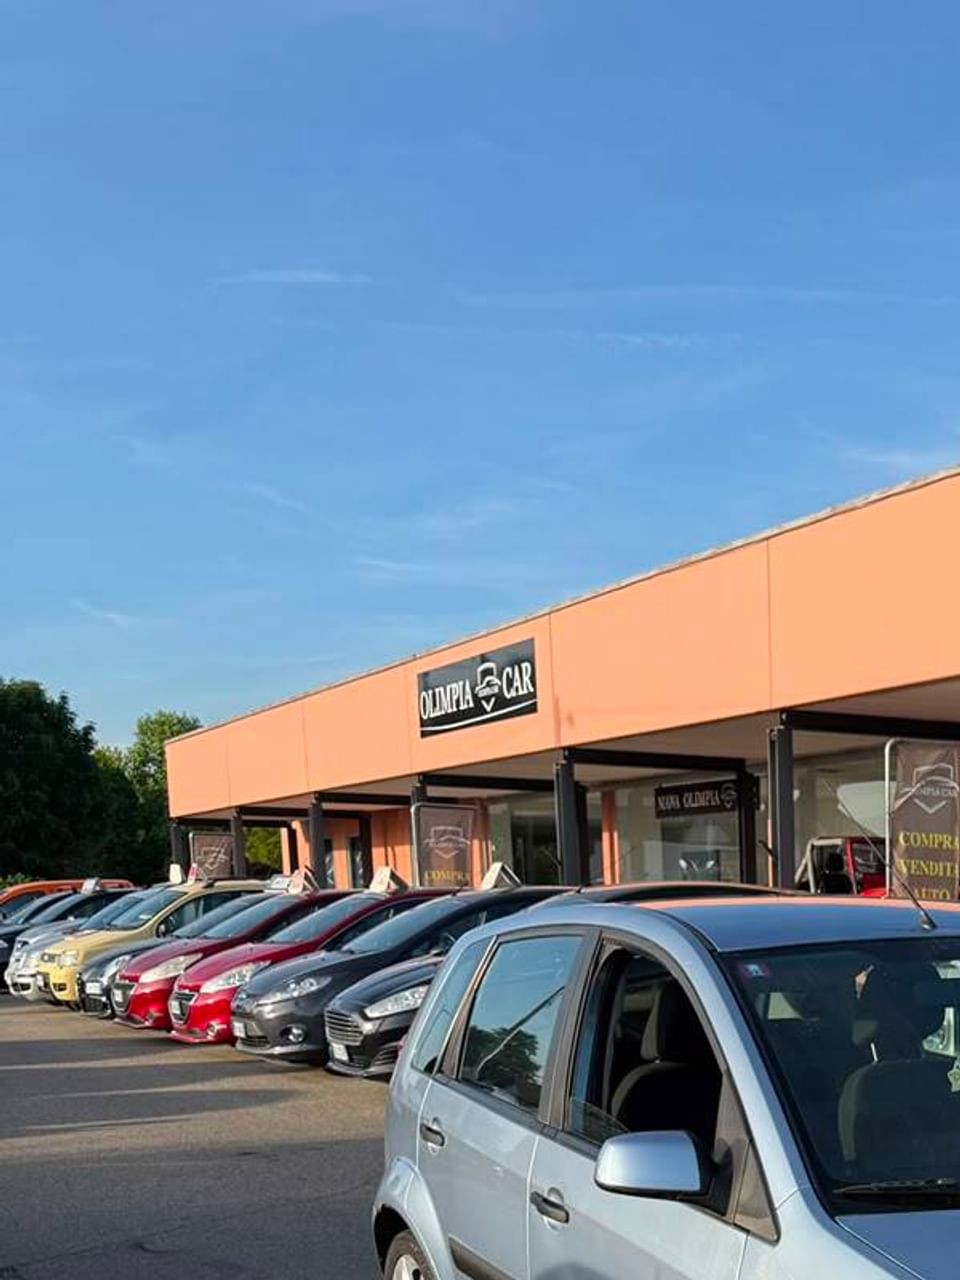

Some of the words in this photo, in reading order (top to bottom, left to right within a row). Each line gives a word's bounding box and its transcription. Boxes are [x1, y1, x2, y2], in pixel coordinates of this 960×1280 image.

[420, 679, 474, 720] OLIMPIA
[502, 662, 534, 699] CAR
[683, 790, 720, 808] OLIMPIA
[899, 831, 960, 850] COMPRA
